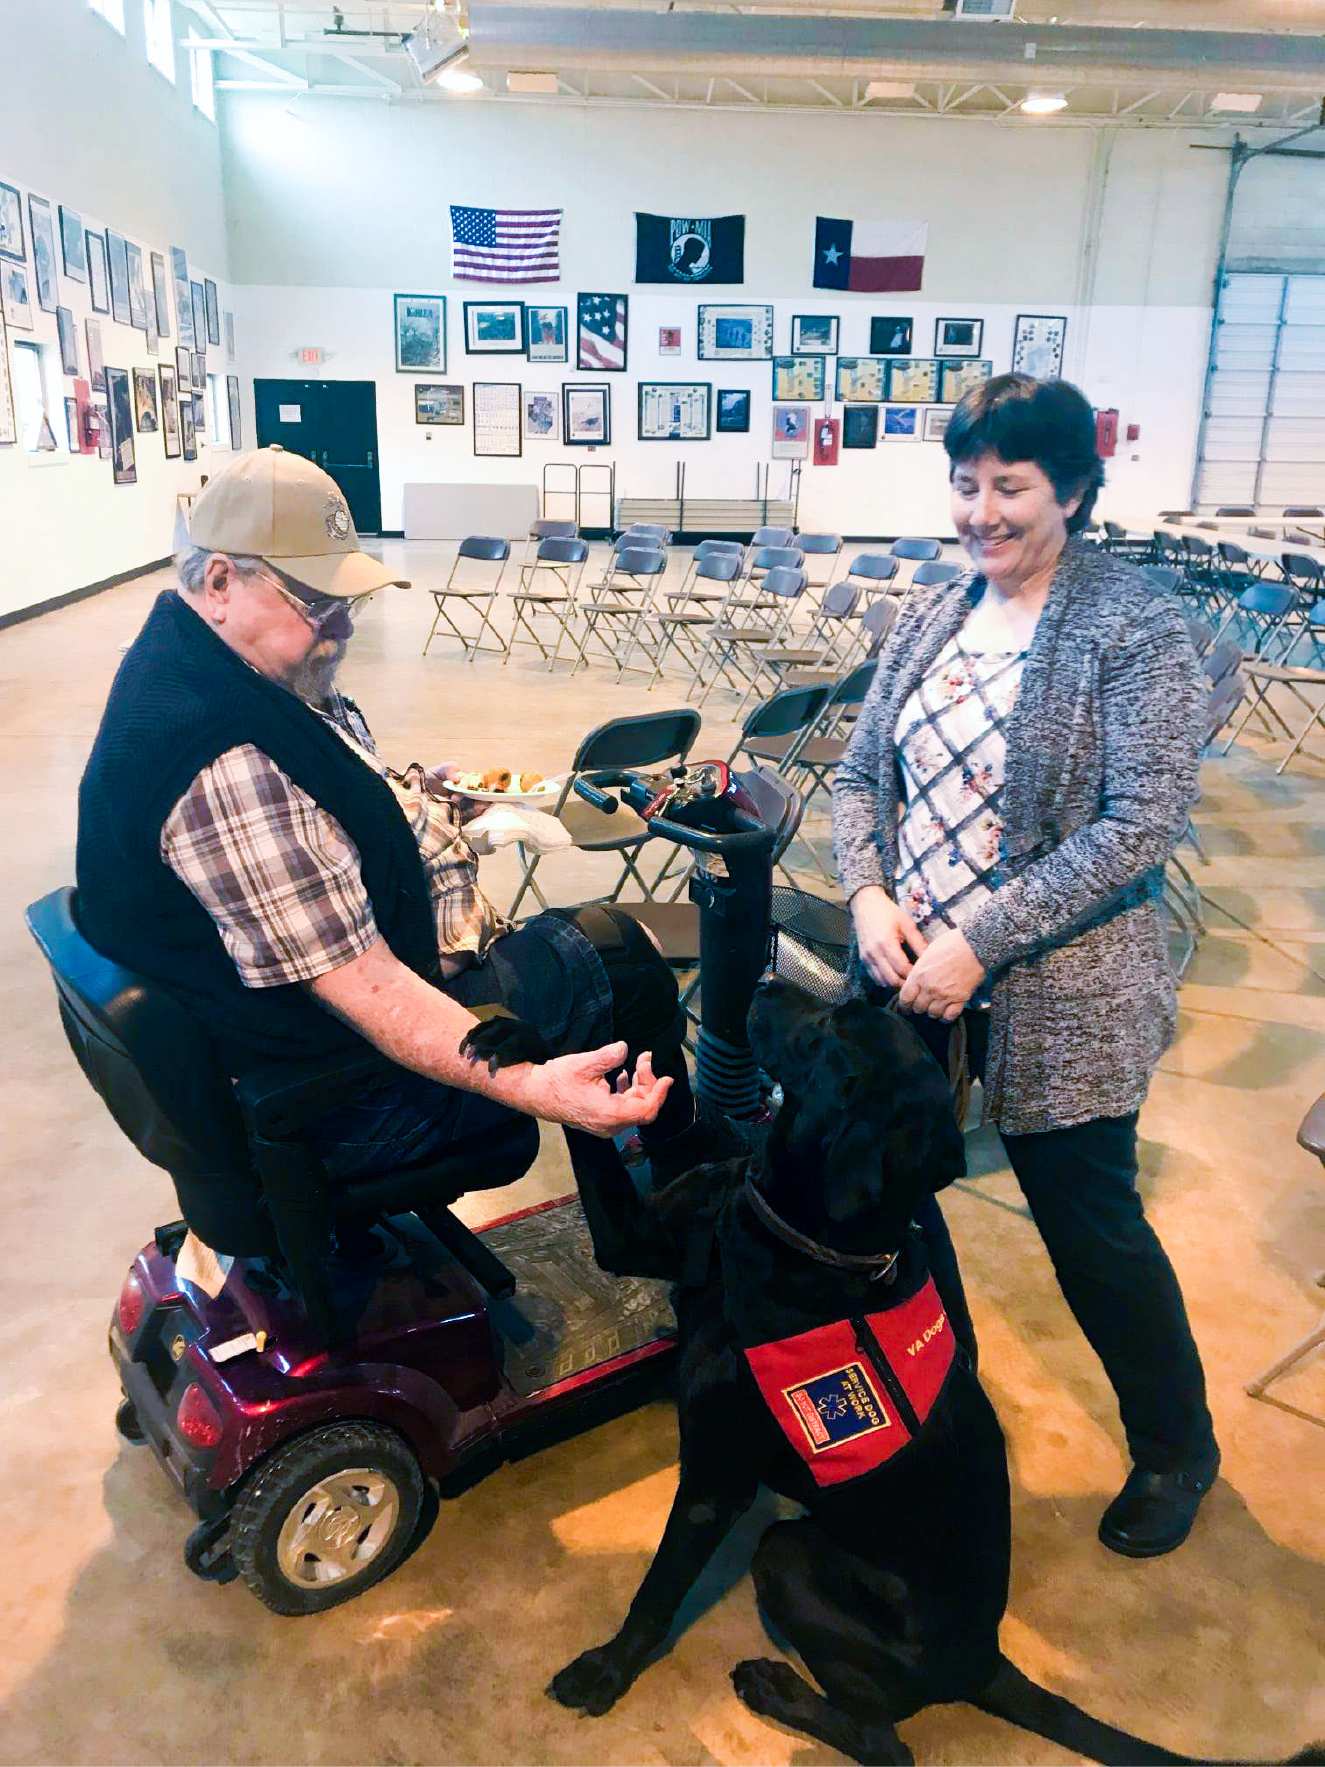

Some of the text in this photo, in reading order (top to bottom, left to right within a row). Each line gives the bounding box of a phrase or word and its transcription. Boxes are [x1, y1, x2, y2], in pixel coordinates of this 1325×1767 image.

[907, 1339, 925, 1356] VA
[841, 1381, 866, 1420] AT WORK
[845, 1368, 880, 1426] SERVICE DOG
